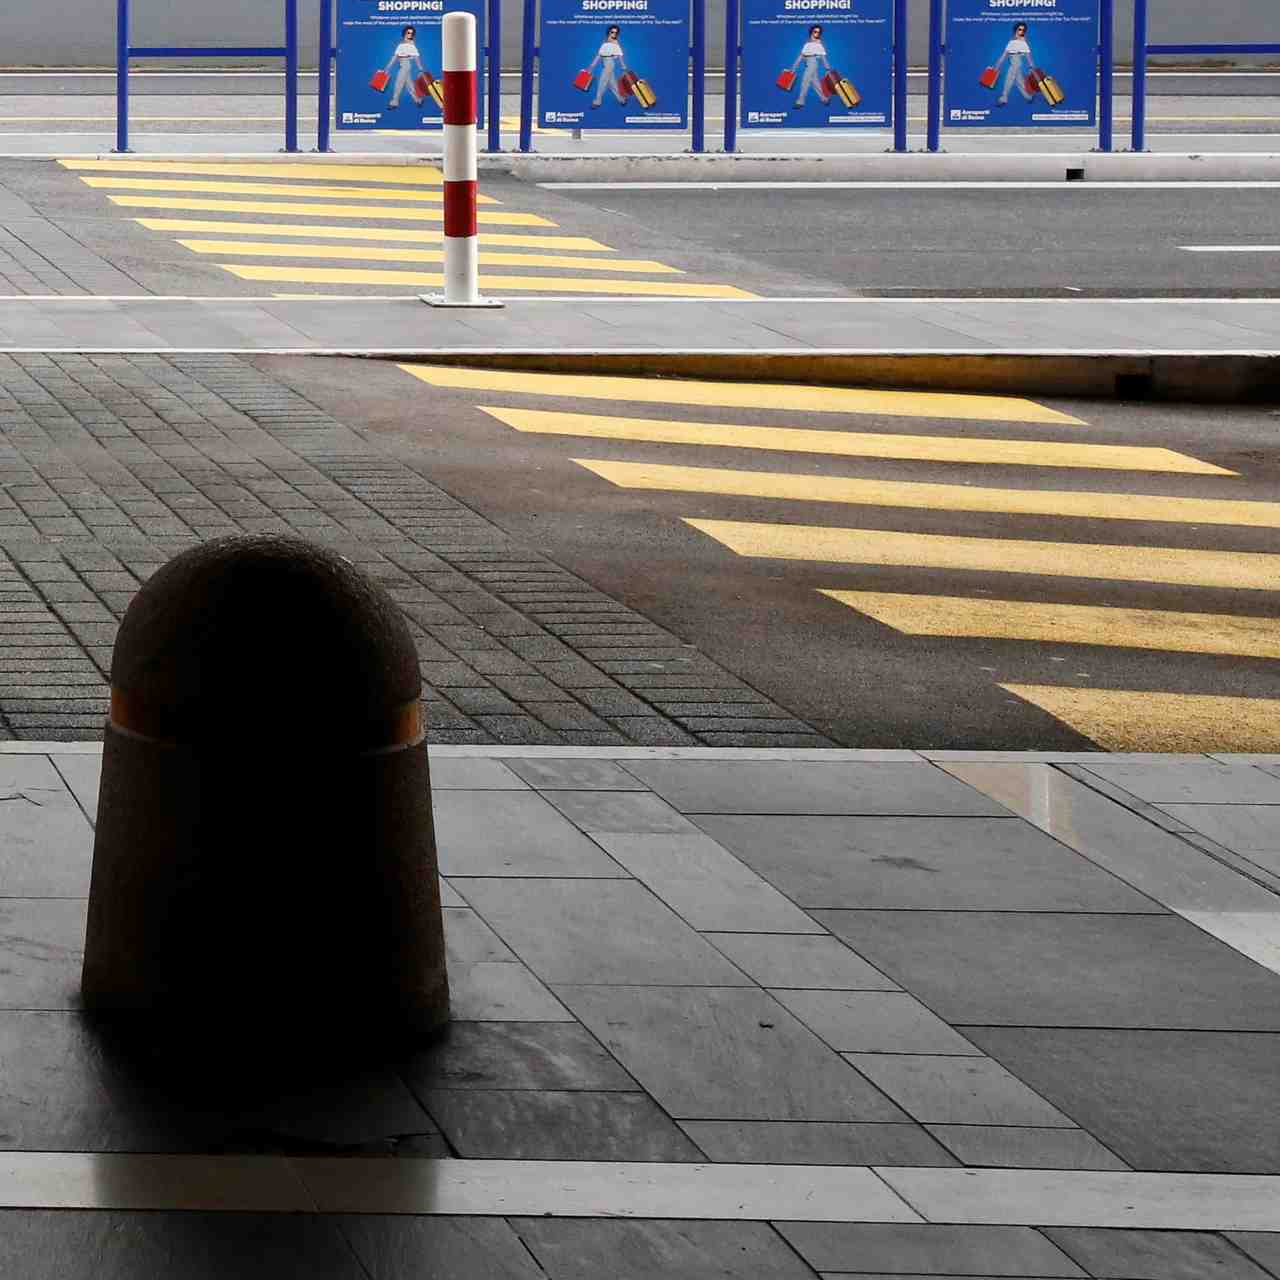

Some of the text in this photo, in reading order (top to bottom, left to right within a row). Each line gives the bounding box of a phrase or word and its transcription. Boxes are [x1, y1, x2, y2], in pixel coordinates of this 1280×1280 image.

[378, 1, 444, 11] SHOPPING!
[582, 0, 648, 10] SHOPPING!
[784, 0, 851, 10] SHOPPING!
